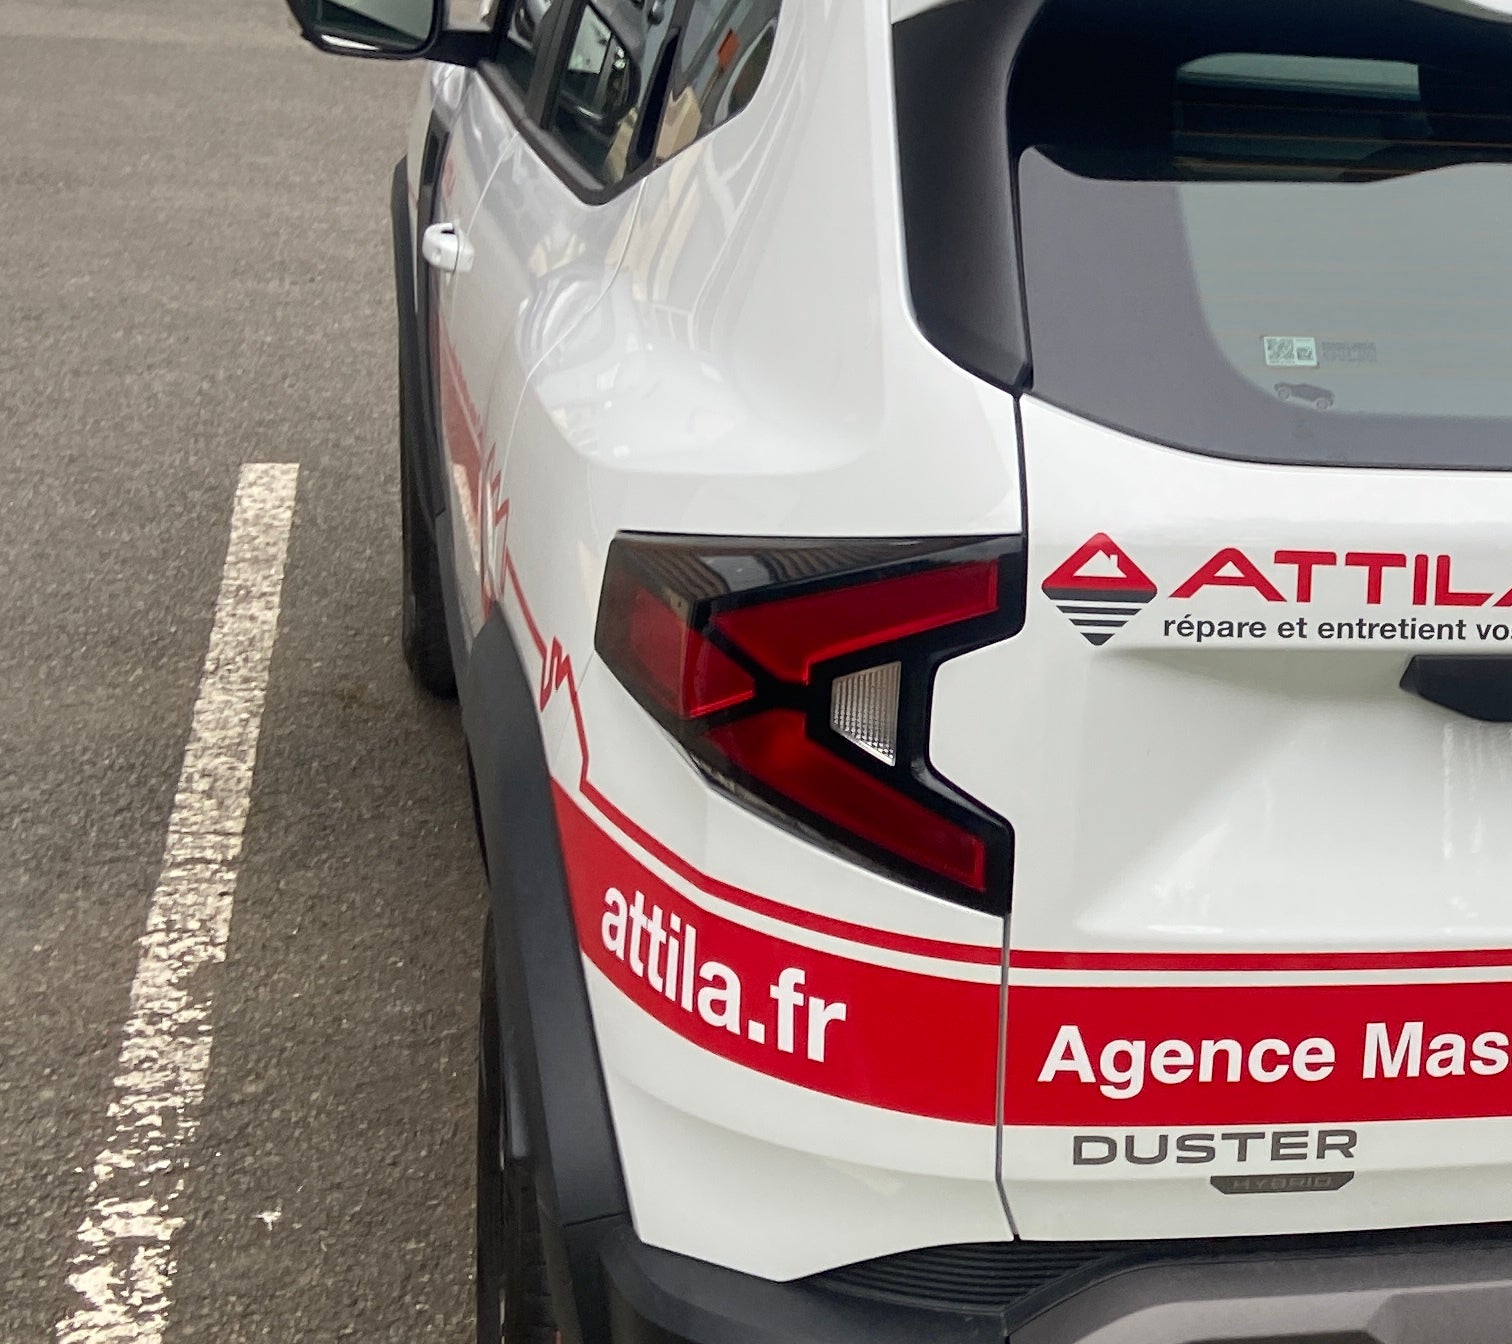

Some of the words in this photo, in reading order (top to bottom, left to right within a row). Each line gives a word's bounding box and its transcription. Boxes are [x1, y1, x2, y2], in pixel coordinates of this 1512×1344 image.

[1163, 614, 1267, 641] répare
[1277, 617, 1308, 640] et
[1317, 617, 1466, 642] entretient
[601, 886, 847, 1063] attila.fr
[1037, 1025, 1336, 1099] Agence
[1073, 1129, 1359, 1166] DUSTER
